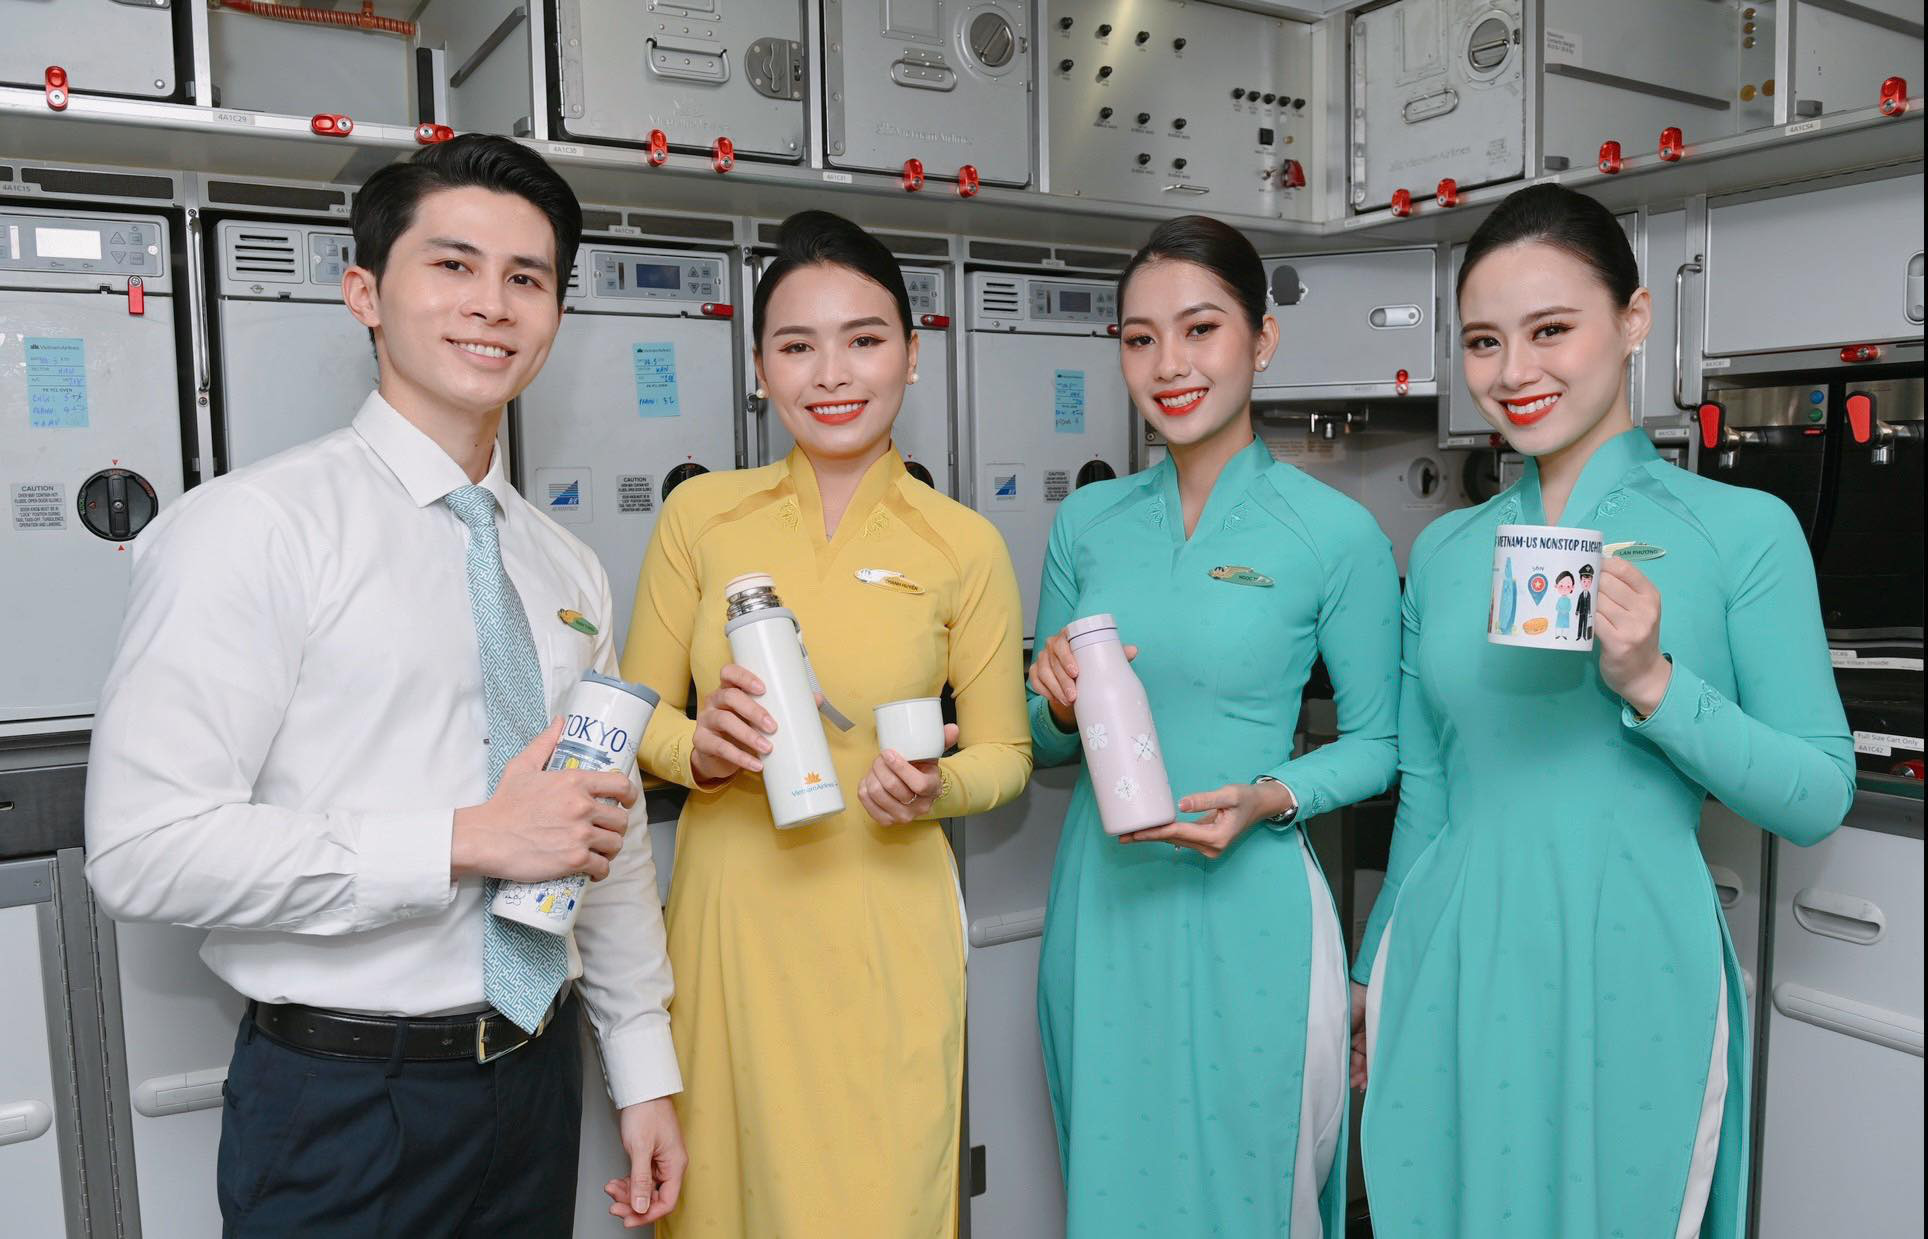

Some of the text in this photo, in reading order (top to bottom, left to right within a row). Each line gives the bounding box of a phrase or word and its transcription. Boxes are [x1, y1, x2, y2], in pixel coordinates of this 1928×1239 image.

[218, 113, 247, 122] 4A1C29
[1539, 536, 1579, 551] NONSTOP
[562, 714, 627, 753] TOKYO
[1887, 736, 1901, 744] Cart
[1902, 738, 1918, 747] Only
